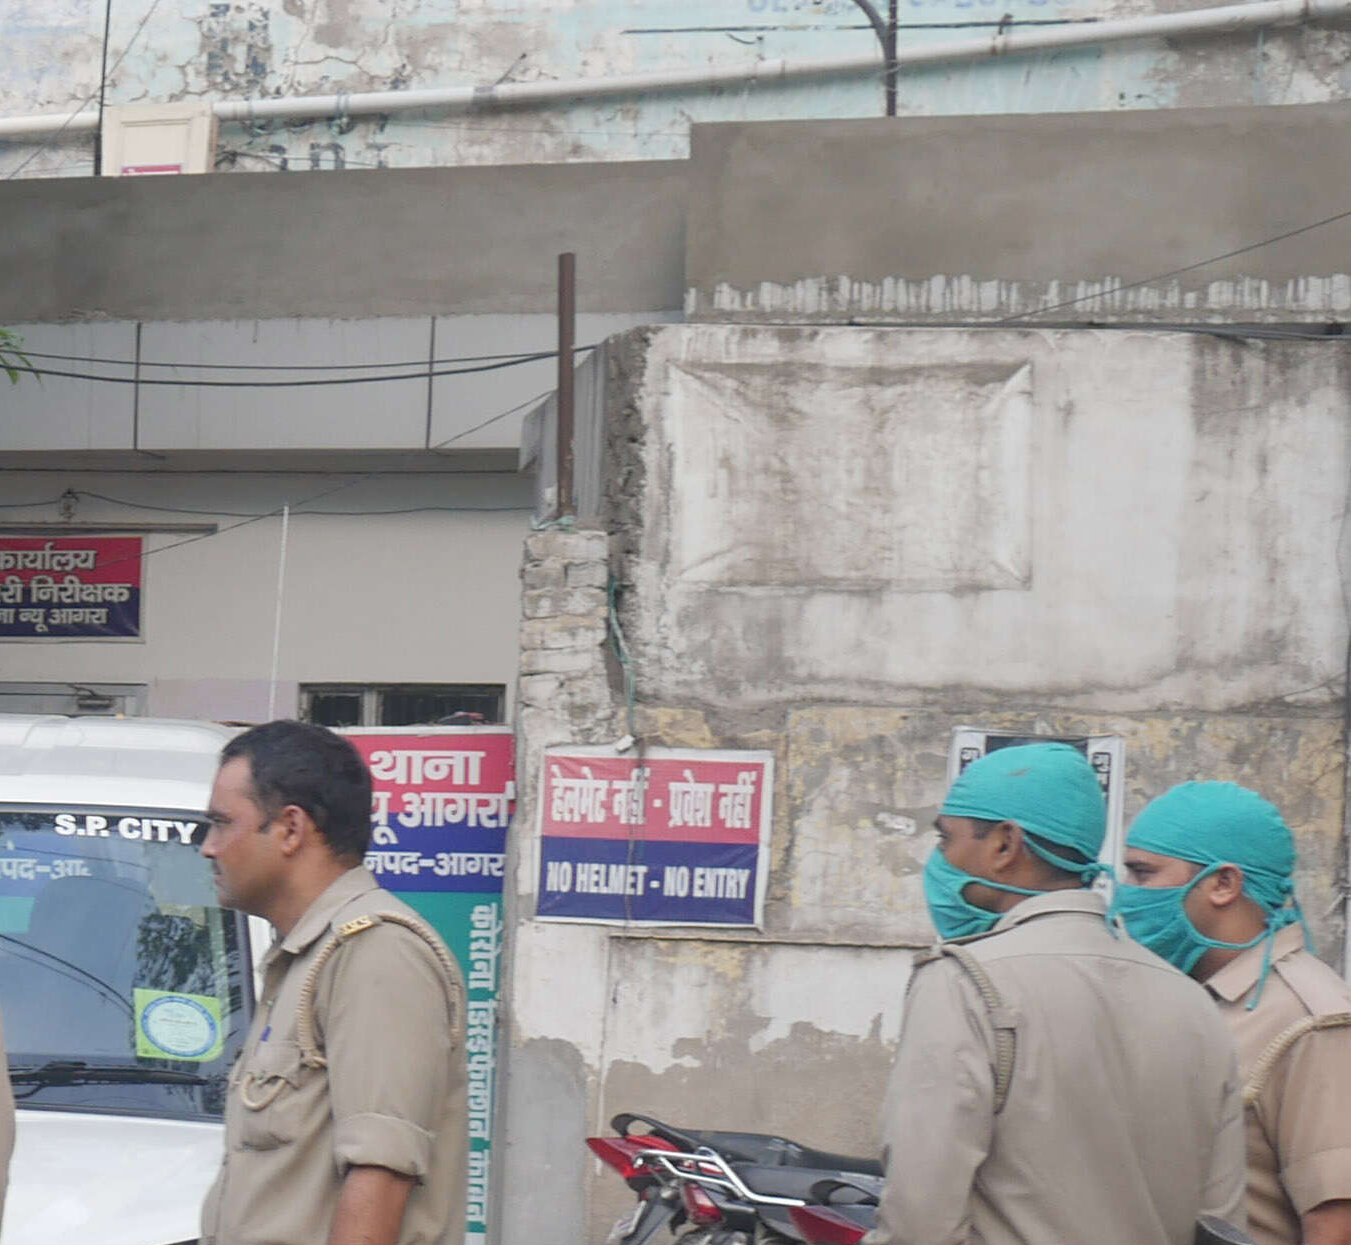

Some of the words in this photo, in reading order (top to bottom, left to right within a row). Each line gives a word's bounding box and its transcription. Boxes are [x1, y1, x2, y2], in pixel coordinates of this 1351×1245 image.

[30, 574, 132, 605] निरीक्षक
[18, 607, 49, 633] न्यू
[49, 607, 109, 625] आगरा
[369, 750, 487, 786] थाना
[550, 764, 609, 824] हेलमेट
[611, 766, 652, 825] नहीं
[668, 769, 715, 828] प्रवेश
[718, 770, 759, 829] नहीं
[54, 814, 111, 838] S.P.
[118, 817, 199, 845] CITY
[545, 860, 573, 893] NO
[575, 862, 649, 896] HELMET
[663, 866, 690, 898] NO
[693, 868, 751, 900] ENTRY
